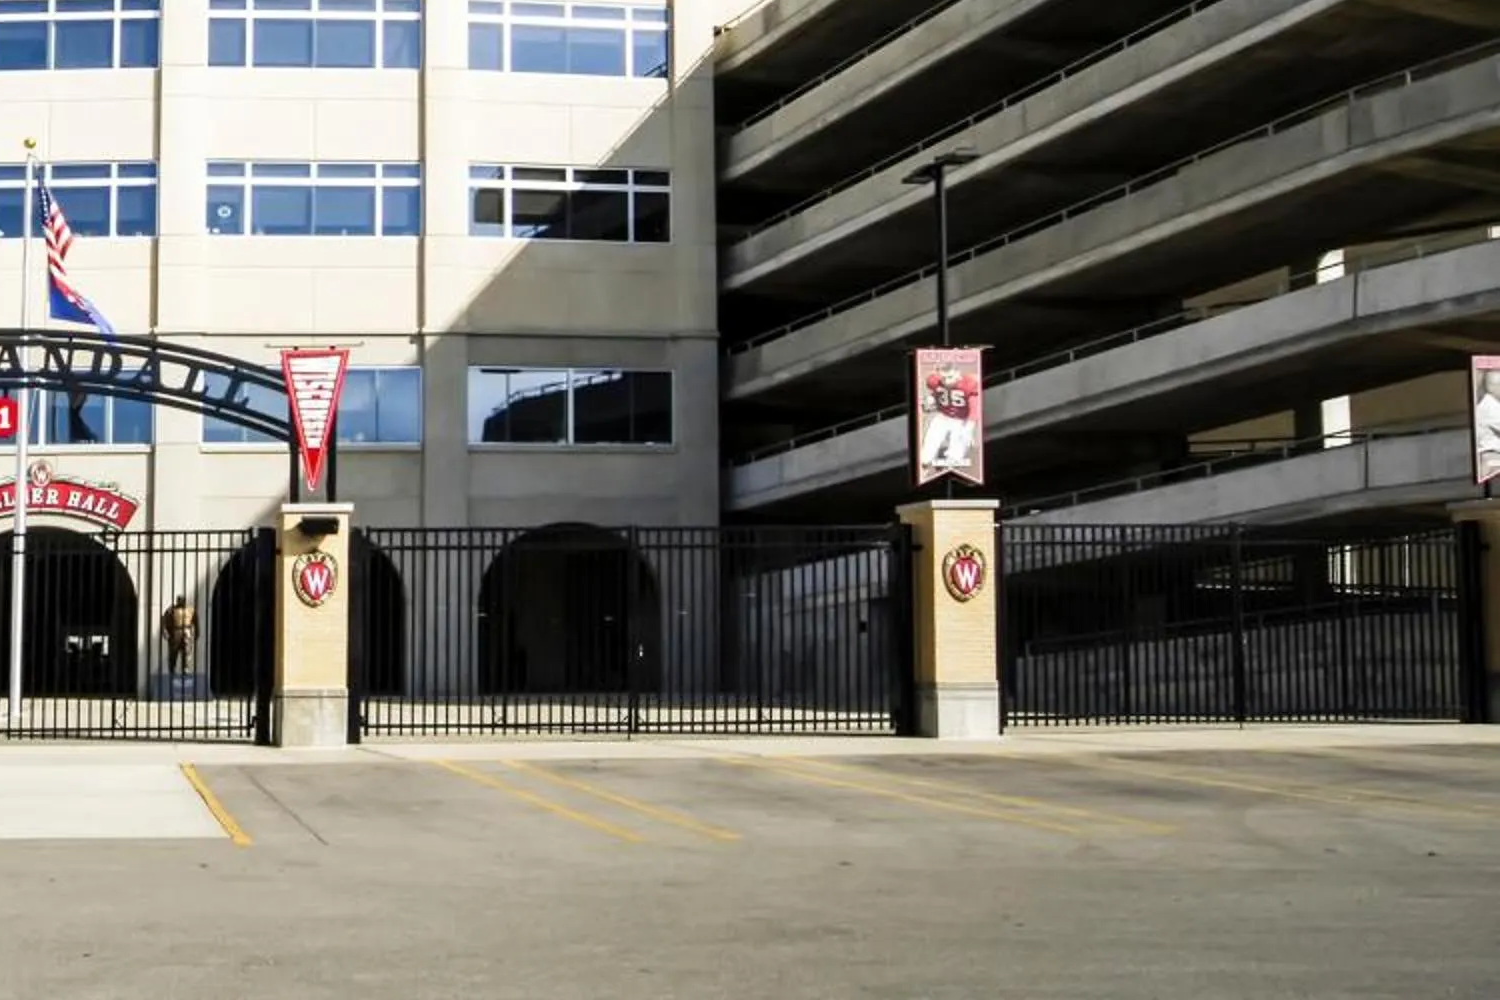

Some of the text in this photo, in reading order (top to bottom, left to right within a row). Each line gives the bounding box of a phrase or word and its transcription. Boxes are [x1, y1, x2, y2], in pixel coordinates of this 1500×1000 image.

[66, 490, 120, 519] HALL
[305, 569, 330, 593] W
[954, 563, 979, 587] W
